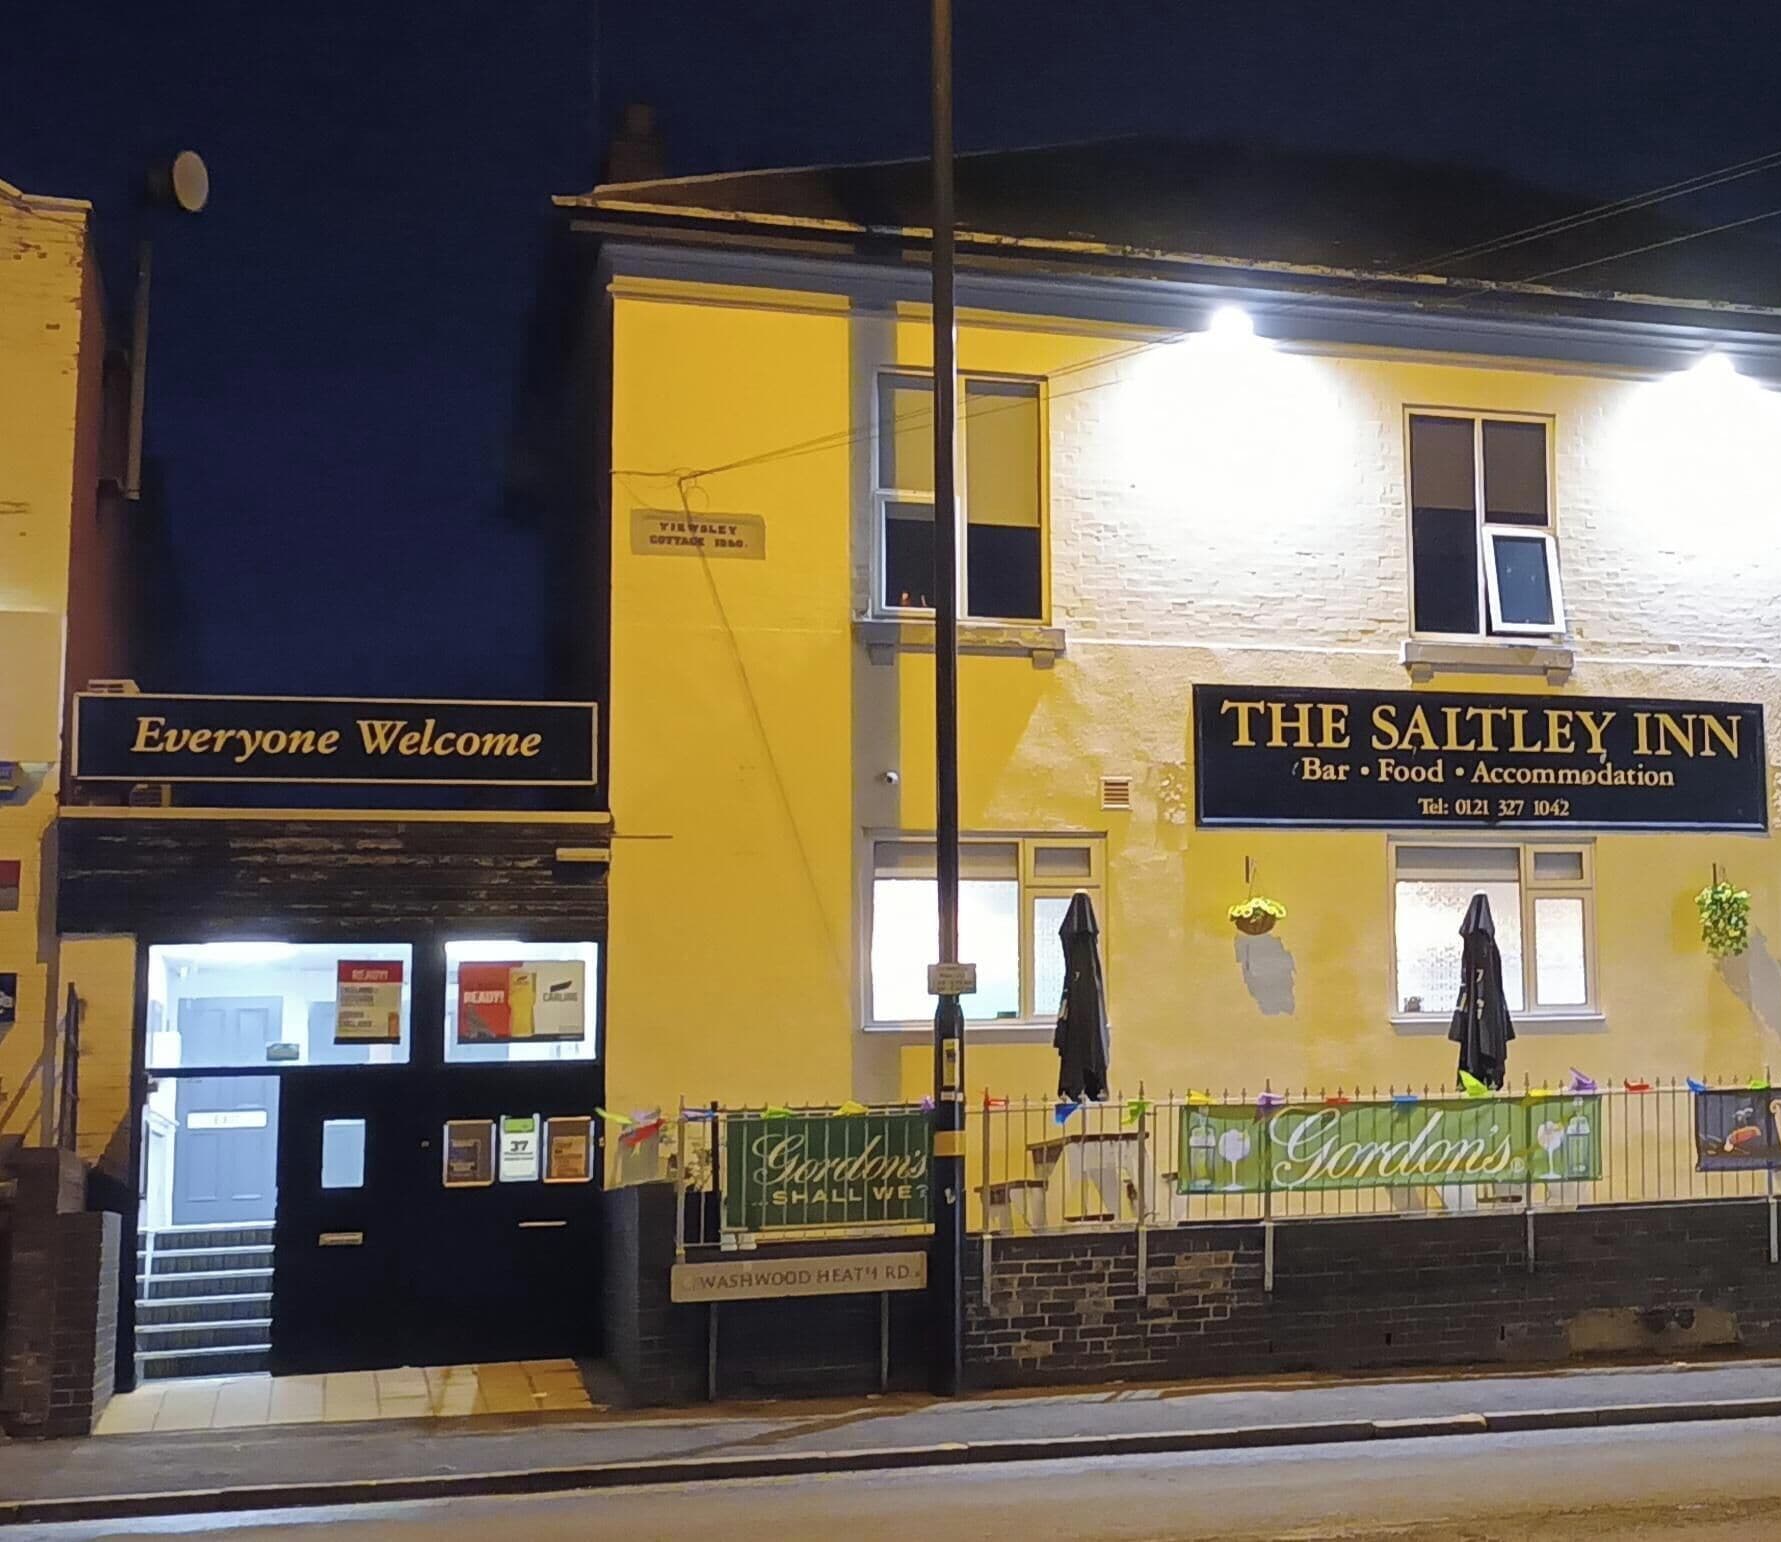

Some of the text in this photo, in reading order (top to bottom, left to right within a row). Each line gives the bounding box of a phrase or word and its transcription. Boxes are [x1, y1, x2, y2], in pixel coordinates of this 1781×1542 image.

[131, 716, 543, 763] Everyone Welcome
[1220, 699, 1743, 759] THE SALTLEY INN
[1301, 757, 1675, 787] Bar Food Accommodation
[1417, 798, 1571, 817] Tel: 0121 327 1042
[751, 1133, 928, 1185] Gordon's
[1269, 1105, 1512, 1188] Gordon's
[701, 1268, 812, 1291] WASHWOOD
